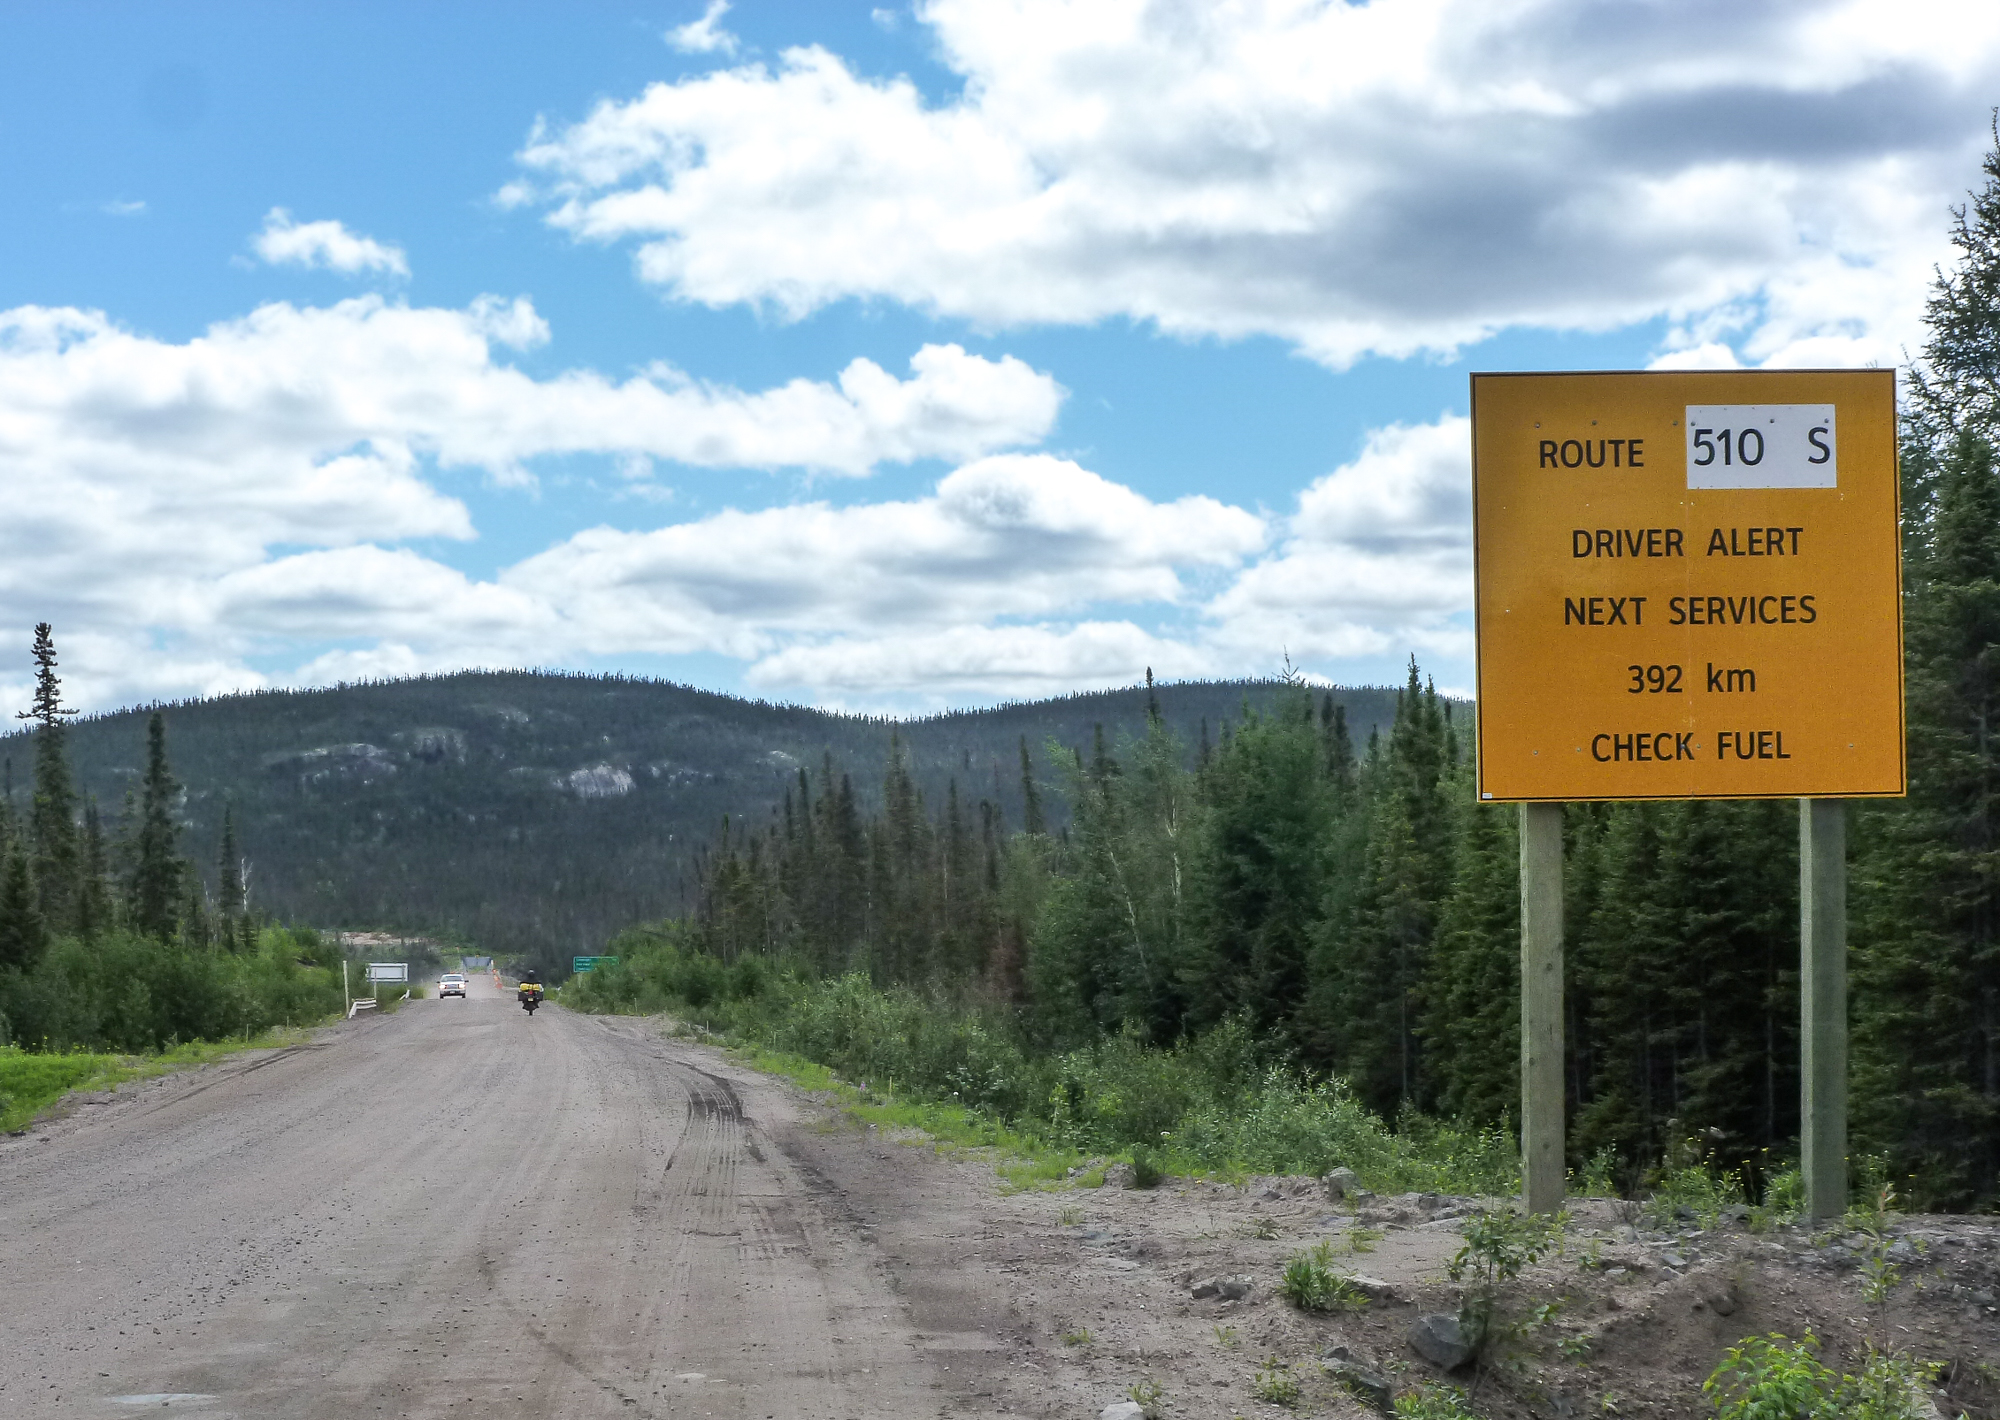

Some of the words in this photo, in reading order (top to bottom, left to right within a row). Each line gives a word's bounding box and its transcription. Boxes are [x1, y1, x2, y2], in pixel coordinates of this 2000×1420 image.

[1540, 439, 1643, 468] ROUTE
[1694, 429, 1763, 465] 510
[1808, 427, 1830, 464] S
[1573, 529, 1683, 557] DRIVER
[1707, 528, 1803, 556] ALERT
[1565, 598, 1646, 625] NEXT
[1670, 596, 1816, 625] SERVICES
[1628, 665, 1682, 693] 392
[1708, 663, 1755, 692] km
[1592, 733, 1694, 762] CHECK
[1718, 731, 1790, 759] FUEL
